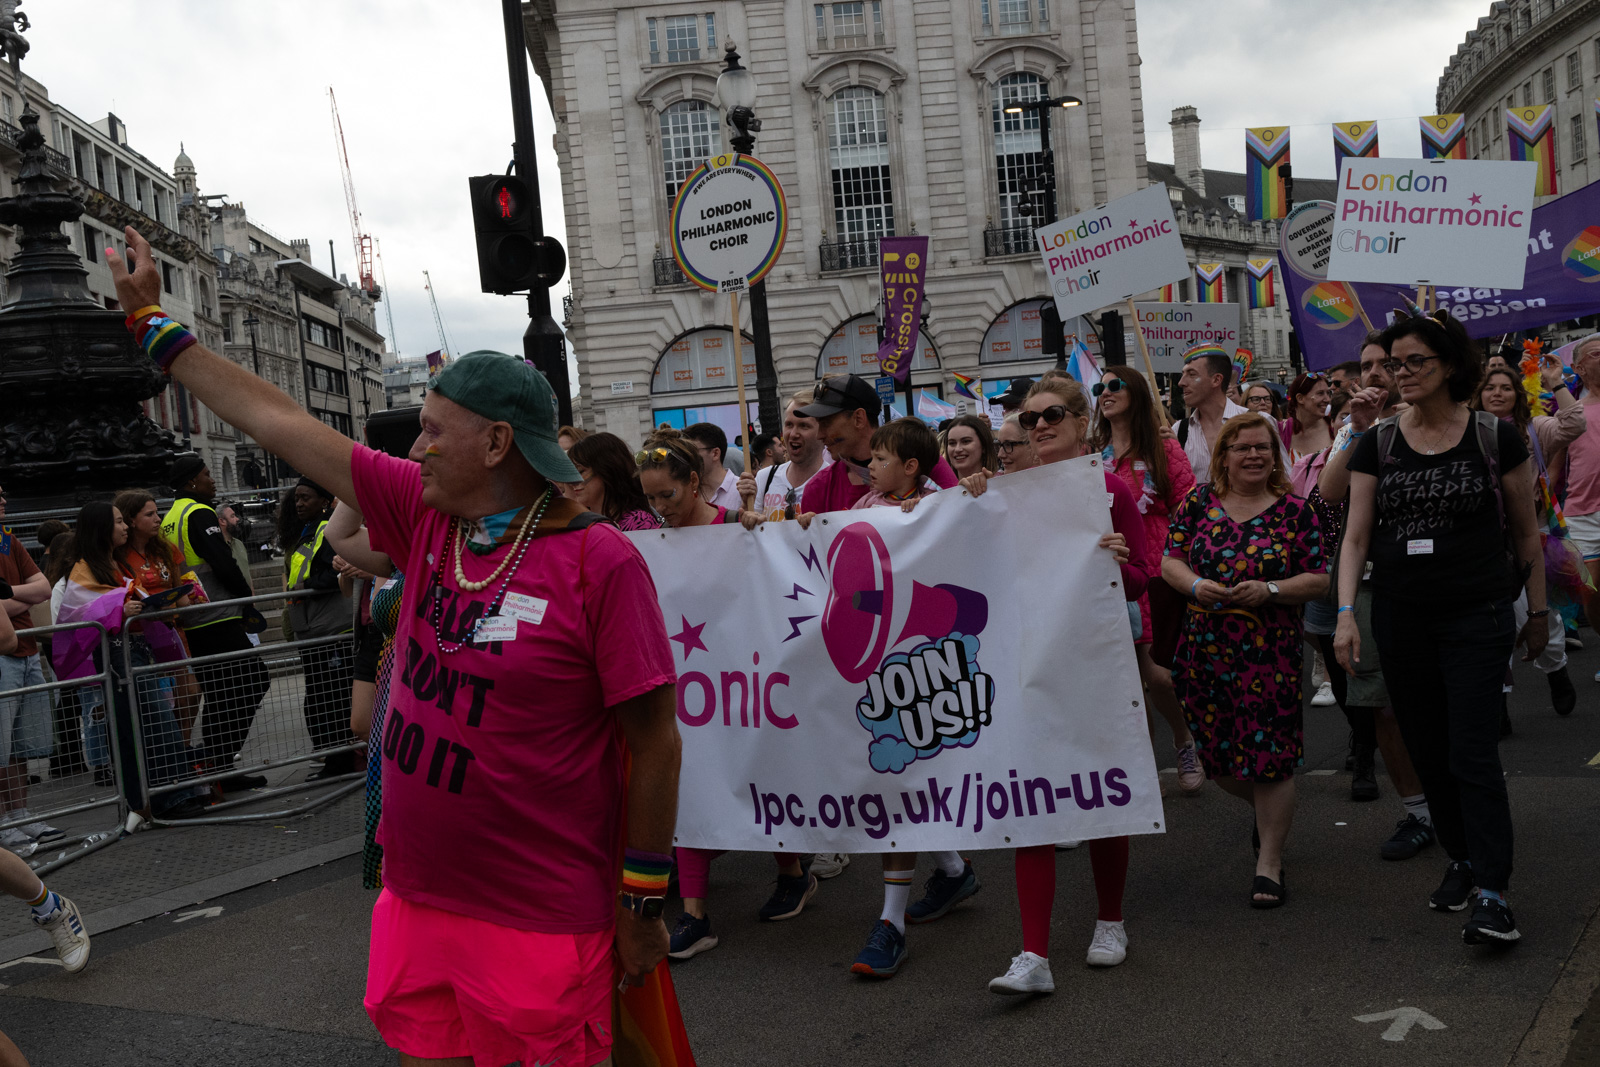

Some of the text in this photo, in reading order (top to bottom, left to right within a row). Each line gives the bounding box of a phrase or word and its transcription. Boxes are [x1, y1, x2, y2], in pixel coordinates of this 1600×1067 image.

[1345, 168, 1448, 193] London
[701, 199, 752, 220] LONDON
[1341, 199, 1524, 228] Philharmonic
[681, 211, 775, 241] PHILHARMONIC
[1041, 215, 1112, 252] London
[1288, 212, 1335, 241] GOVERNMENT
[1305, 228, 1328, 243] LEGAL
[709, 234, 749, 251] CHOIR
[1048, 219, 1173, 275] Philharmonic
[1336, 229, 1406, 254] Choir
[1054, 268, 1101, 298] Choir
[1137, 309, 1193, 322] London
[1317, 296, 1347, 308] LGBT+
[1137, 343, 1175, 357] hoir
[1450, 460, 1473, 475] TE
[503, 601, 544, 616] Philharmonic
[401, 636, 495, 728] DON'T
[859, 639, 965, 720] JOIN
[898, 672, 992, 750] US!!
[383, 707, 476, 795] DO IT
[749, 767, 1132, 839] lpc.org.uk/join-us
